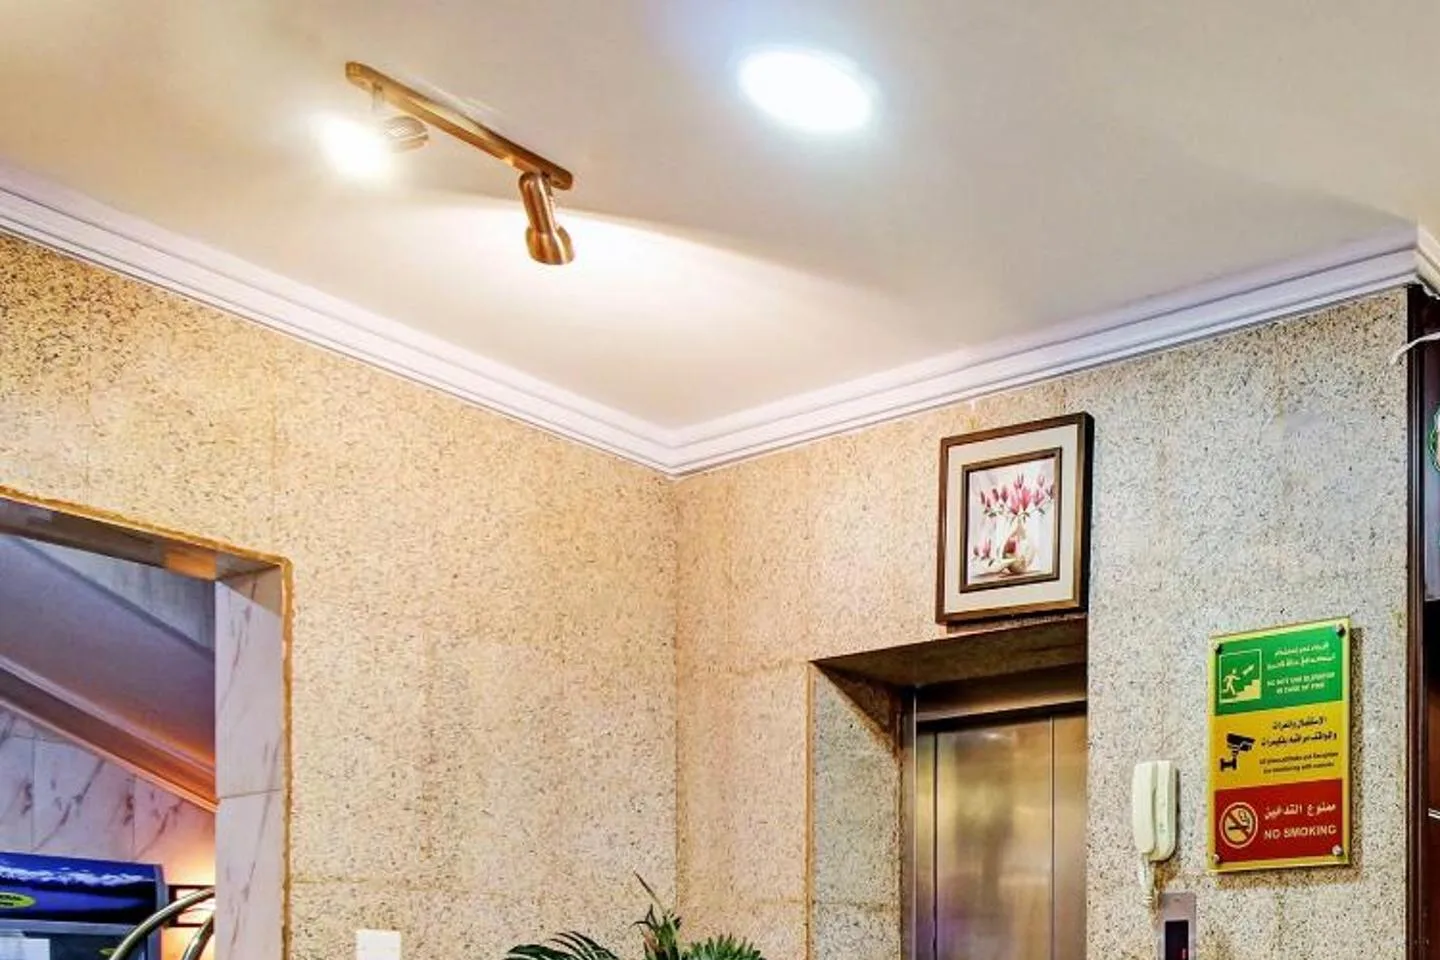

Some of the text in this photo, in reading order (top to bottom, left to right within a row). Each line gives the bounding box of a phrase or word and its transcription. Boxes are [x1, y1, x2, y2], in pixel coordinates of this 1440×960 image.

[1306, 802, 1337, 817] ممنوع
[1264, 824, 1337, 840] NO SMOKING
